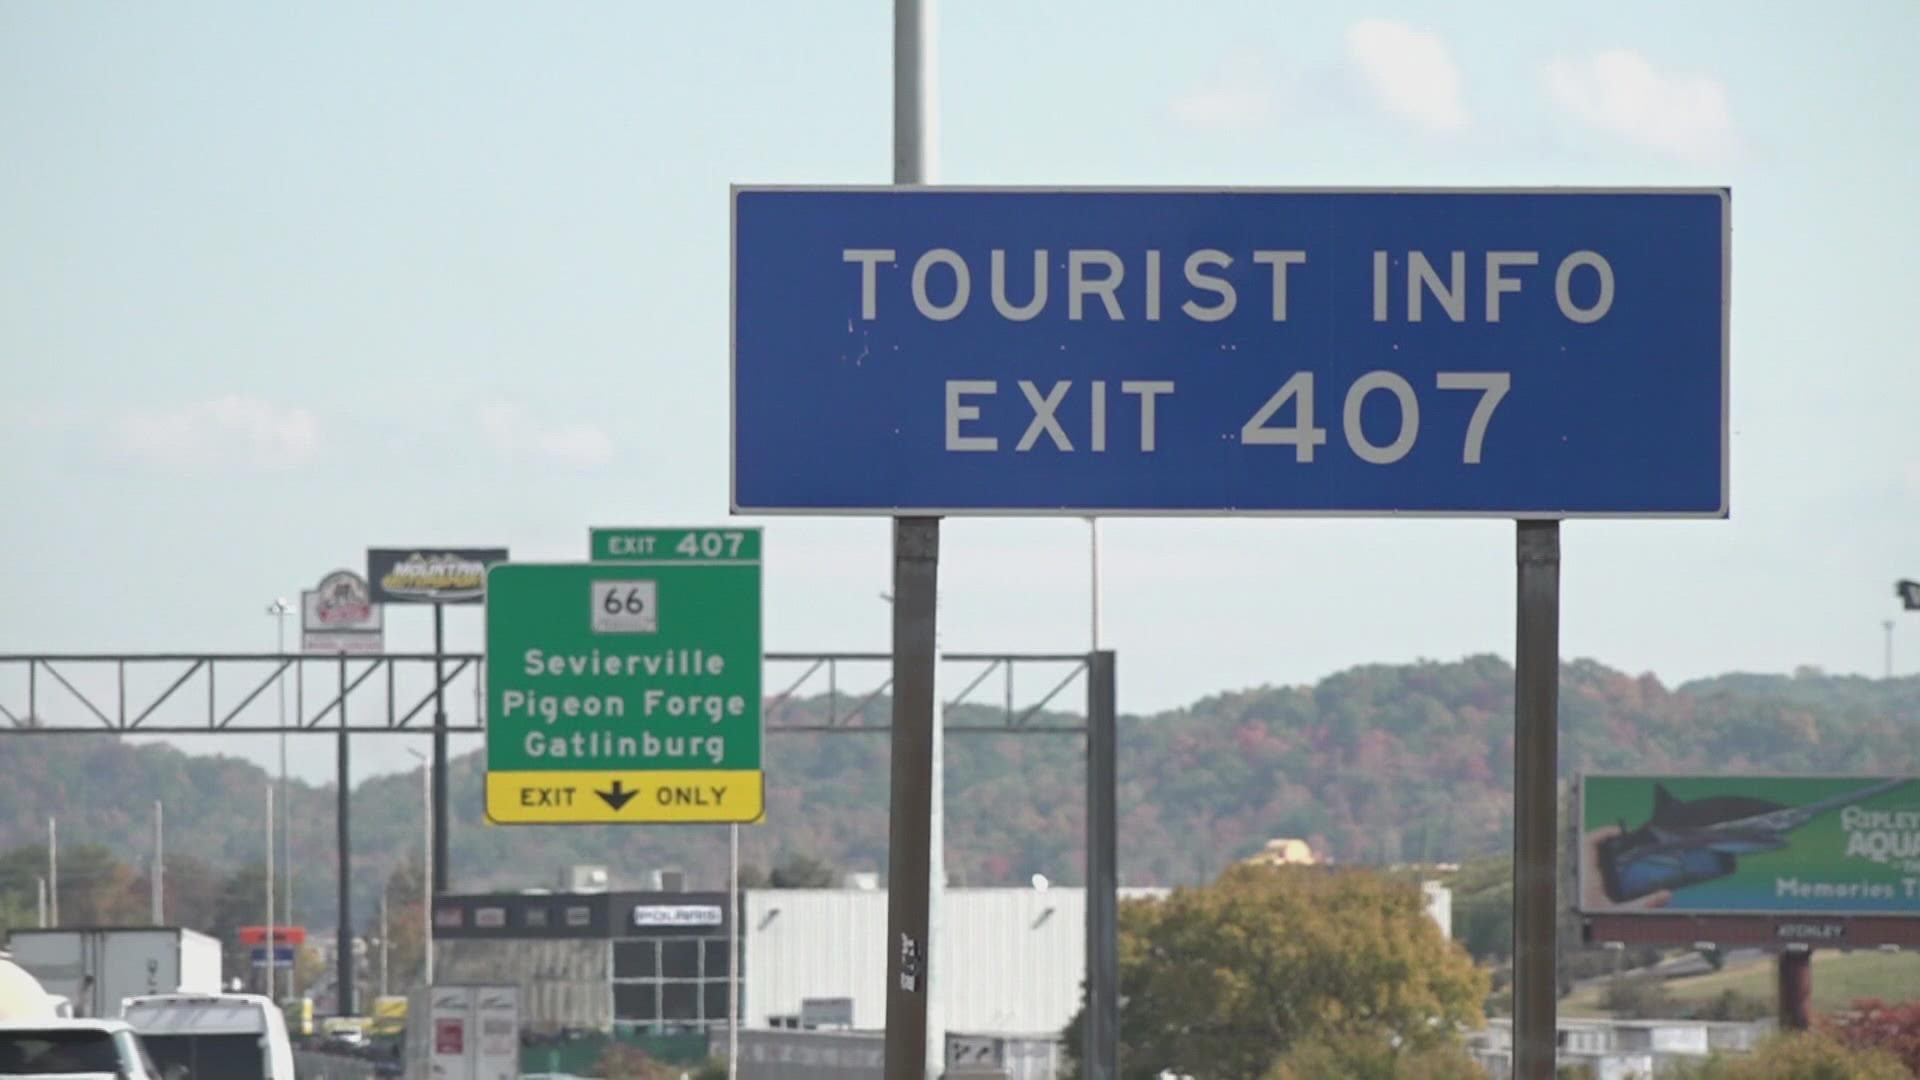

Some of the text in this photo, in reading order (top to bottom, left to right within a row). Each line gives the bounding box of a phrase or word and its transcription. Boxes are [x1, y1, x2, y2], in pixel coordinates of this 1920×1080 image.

[842, 248, 1616, 325] TOURIST INFO
[944, 370, 1512, 465] EXIT 407
[608, 532, 745, 558] EXIT 407
[603, 588, 644, 615] 66
[524, 648, 725, 677] Sevierville
[502, 689, 746, 724] Pigeon Forge
[524, 731, 725, 764] Gatlinburg
[520, 786, 727, 807] EXIT ONLY
[1775, 876, 1895, 898] Memories
[637, 909, 719, 921] POLARIS
